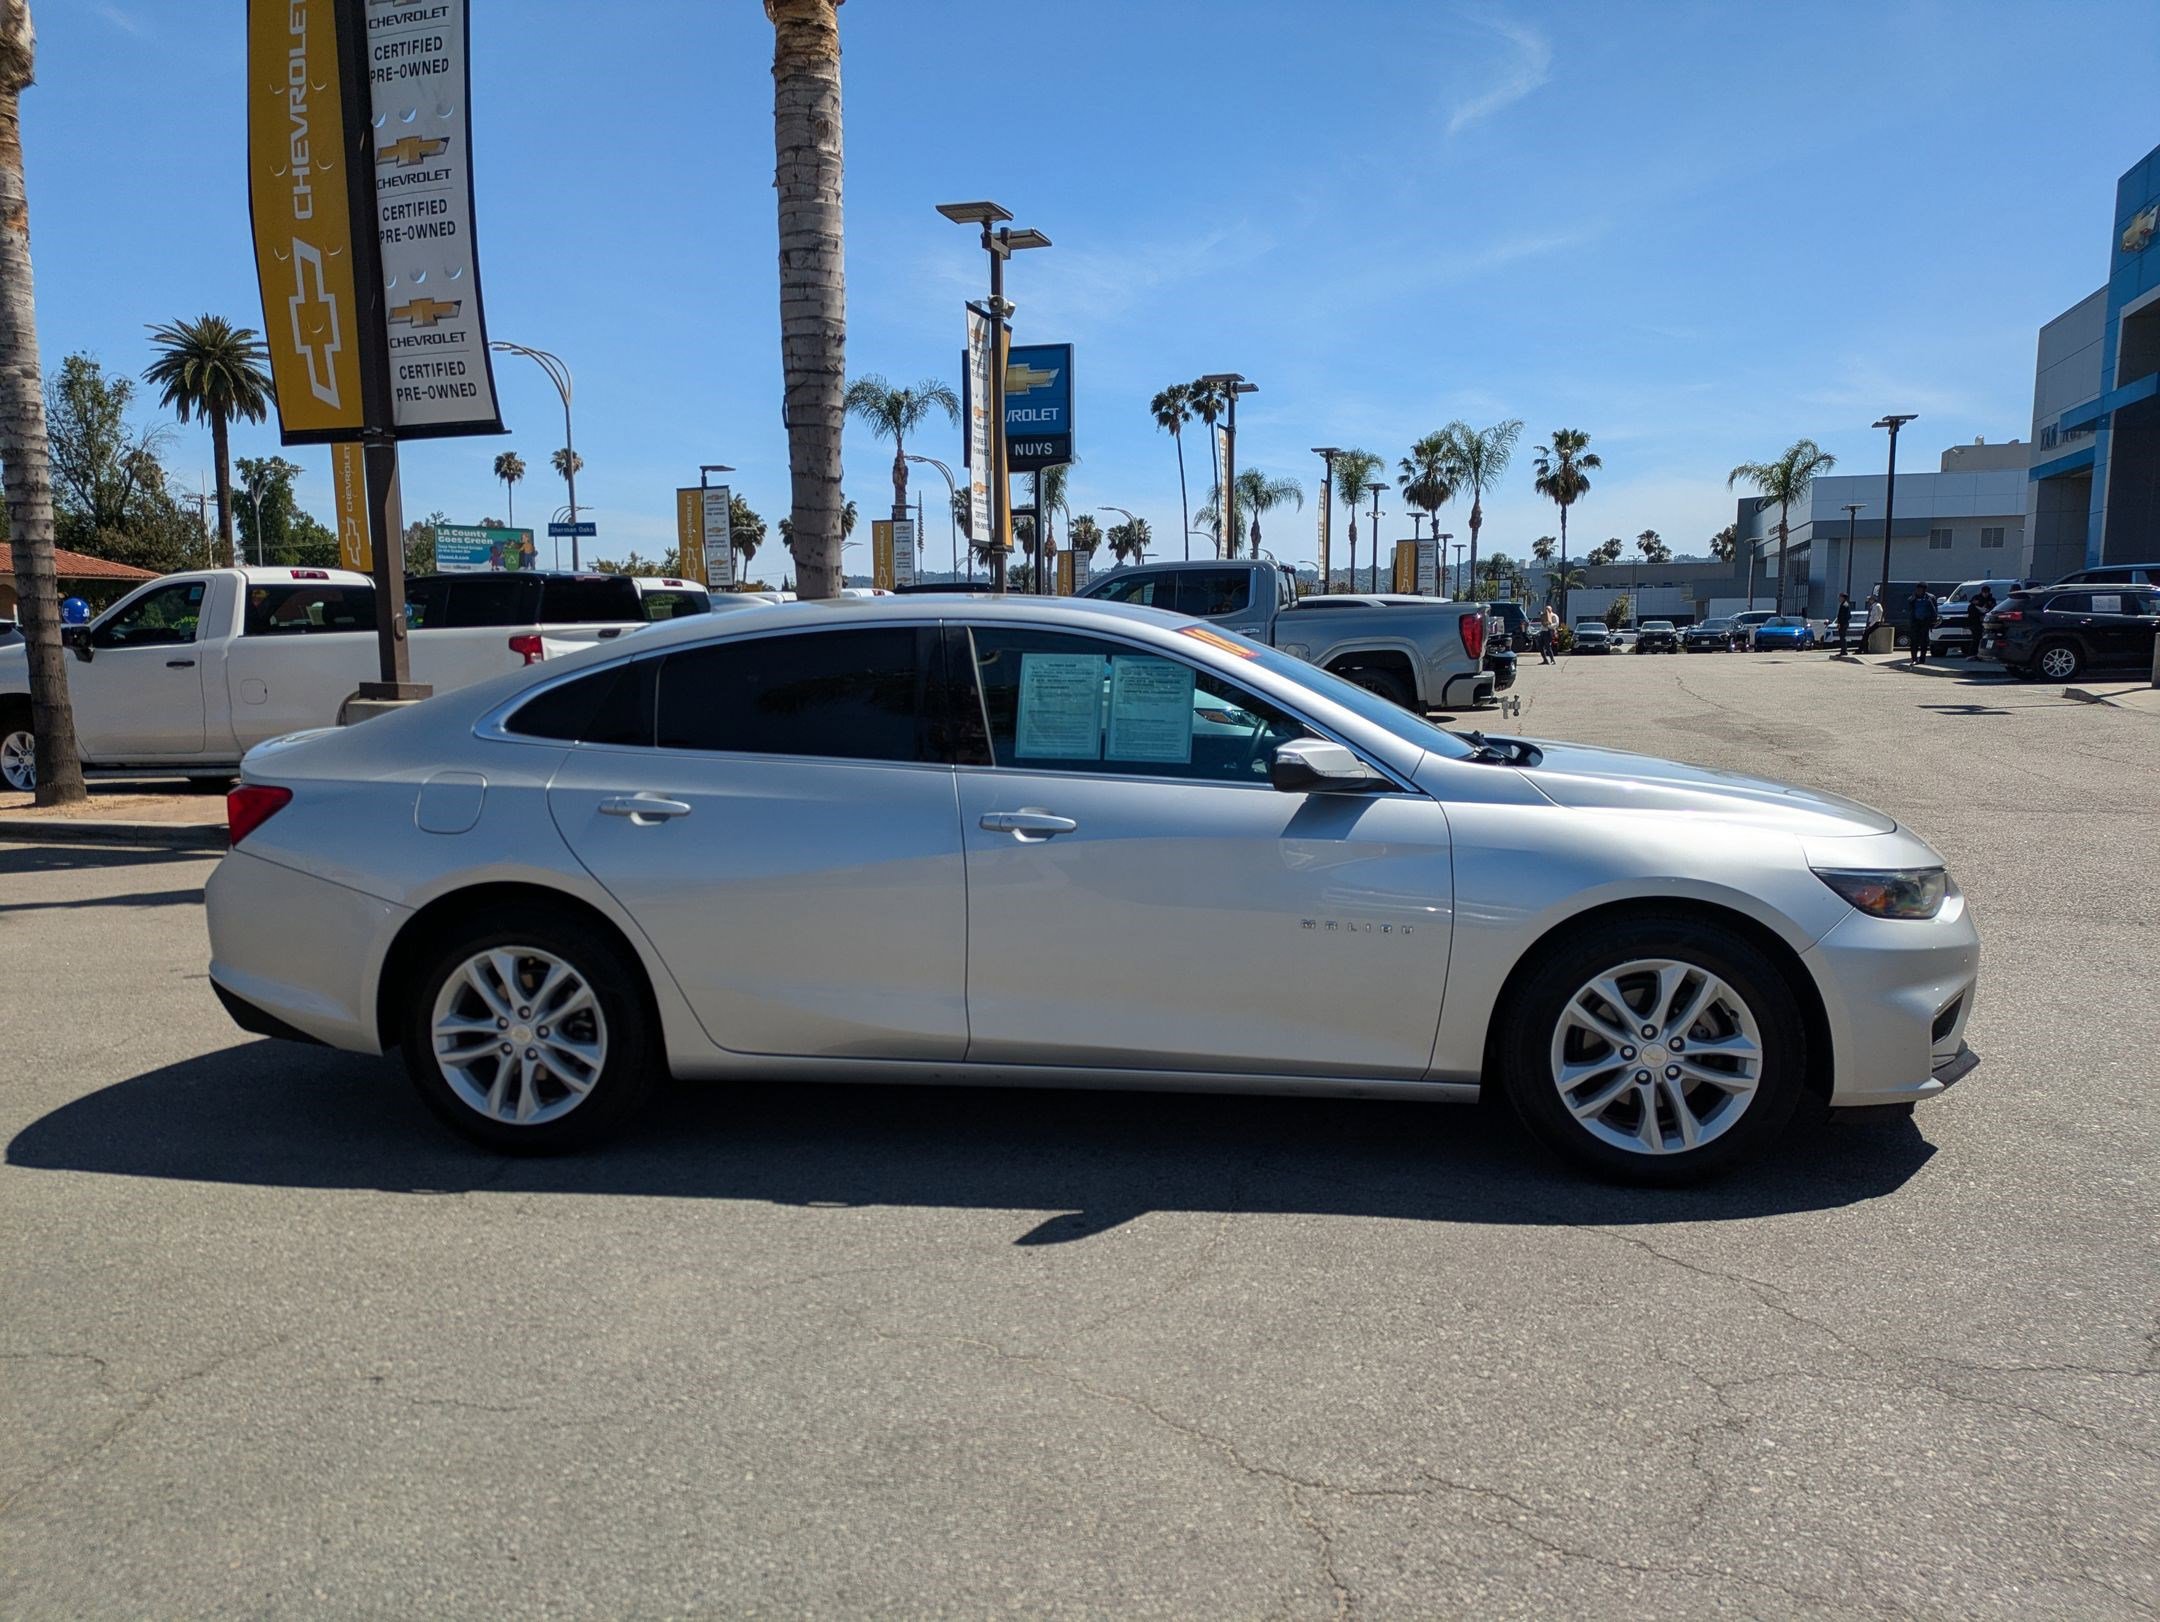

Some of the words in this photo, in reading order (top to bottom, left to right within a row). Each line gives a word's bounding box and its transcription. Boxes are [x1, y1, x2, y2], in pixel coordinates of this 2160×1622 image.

[368, 6, 449, 29] CHEVROLET
[374, 36, 443, 61] CERTIFIED
[369, 58, 449, 84] PRE-OWNED
[289, 0, 313, 220] CHEVROLE
[376, 168, 452, 190] CHEVROLET
[382, 199, 447, 221] CERTIFIED
[380, 220, 456, 244] PRE-OWNED
[389, 331, 466, 349] CHEVROLET
[399, 361, 466, 380] CERTIFIED
[396, 382, 477, 402] PRE-OWNED
[1014, 442, 1053, 456] NUYS
[438, 536, 463, 544] Goes
[465, 537, 493, 545] Green
[452, 530, 487, 538] County
[1300, 919, 1414, 935] MALIBU
